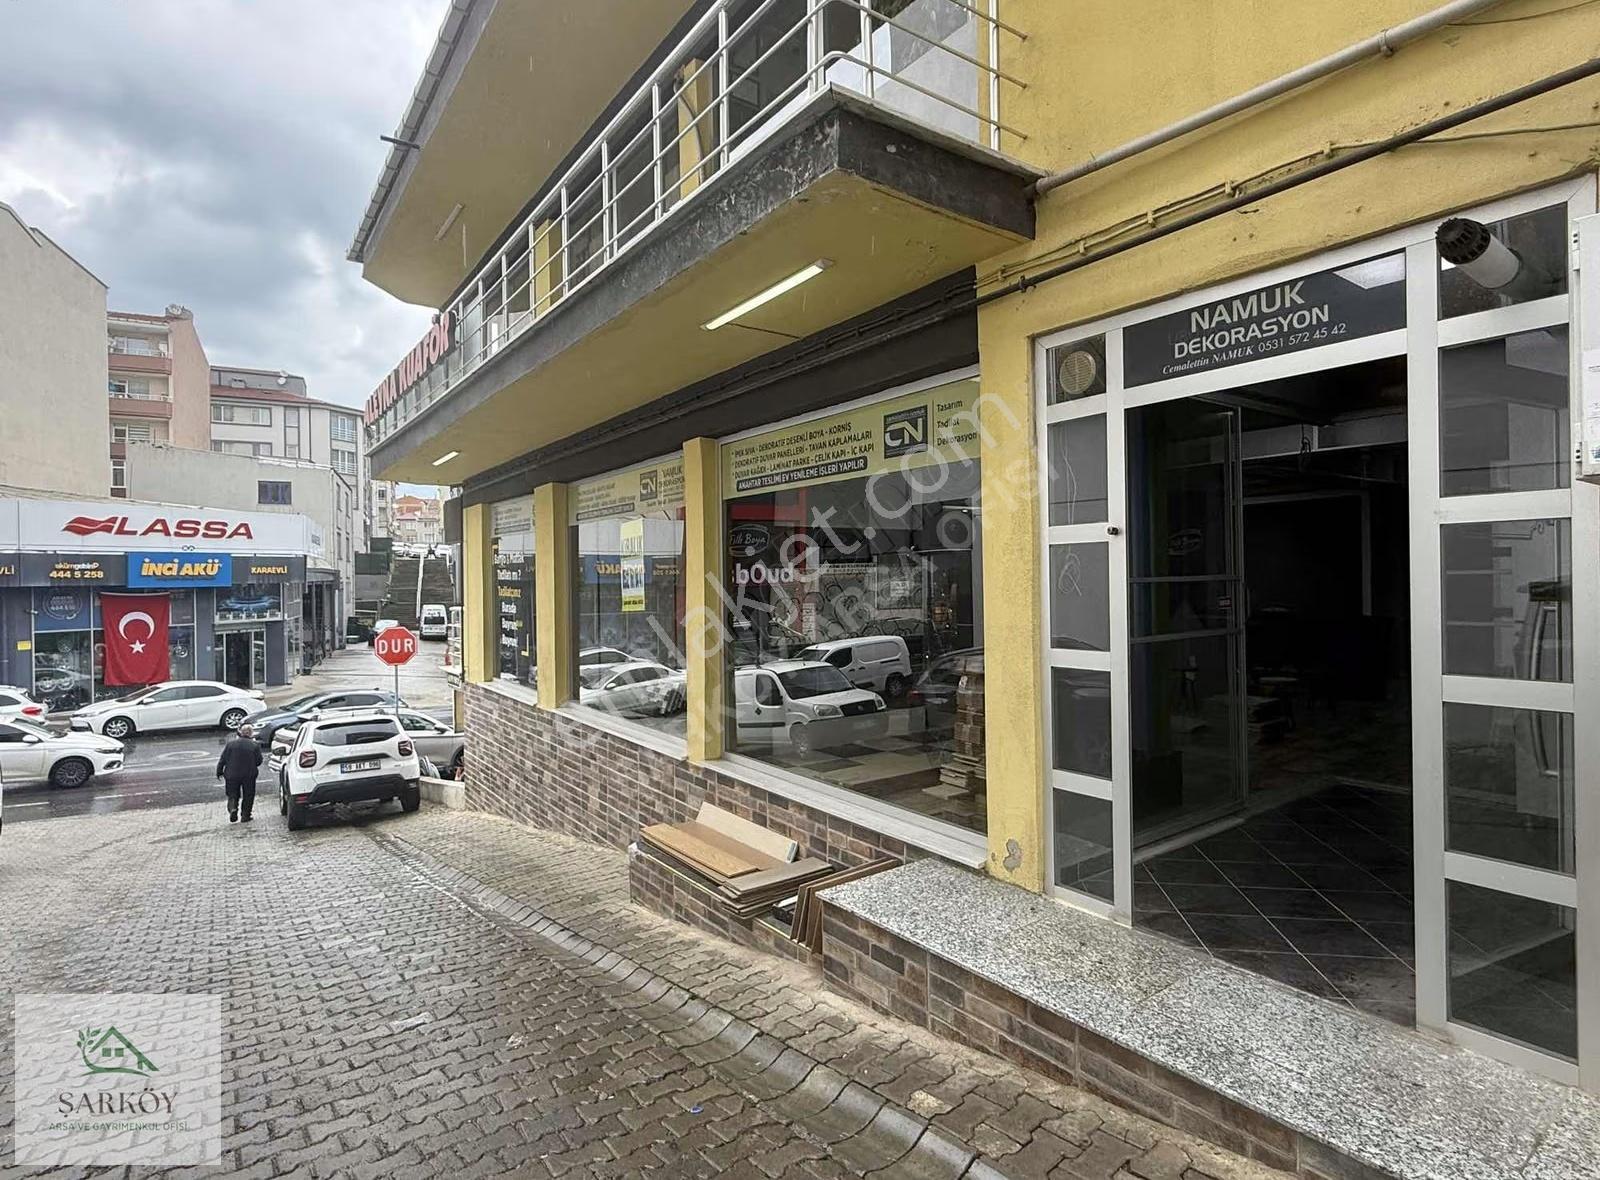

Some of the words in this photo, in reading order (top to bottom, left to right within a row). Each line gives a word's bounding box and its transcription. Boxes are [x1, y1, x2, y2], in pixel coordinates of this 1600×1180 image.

[1190, 280, 1305, 333] NAMUK
[1174, 303, 1330, 359] DEKORASYON
[399, 310, 452, 393] KUAFÖR
[1162, 355, 1209, 375] Cemalettin
[1211, 344, 1254, 365] NAMUK
[1257, 337, 1287, 354] 0531
[1288, 332, 1311, 348] 572
[1312, 328, 1329, 343] 45
[1330, 322, 1347, 337] 42
[937, 399, 963, 412] Tasarım
[808, 430, 825, 440] BOYA
[808, 441, 827, 453] TAVAN
[827, 429, 872, 448] KAPLAMALARI
[884, 417, 923, 447] CN
[936, 430, 977, 446] Dekorasyon
[792, 456, 811, 467] PARKE
[814, 451, 832, 464] ÇELİK
[831, 447, 847, 459] KAPI
[858, 443, 874, 454] KAPI
[738, 478, 762, 490] ANAHTAR
[839, 458, 864, 471] YAPILIR
[114, 517, 254, 540] LASSA
[744, 533, 766, 547] Boya
[49, 570, 71, 579] 444
[74, 570, 81, 579] 5
[83, 570, 104, 579] 258
[141, 558, 179, 576] İNCİ
[180, 558, 221, 576] AKÜ
[378, 638, 414, 655] DUR
